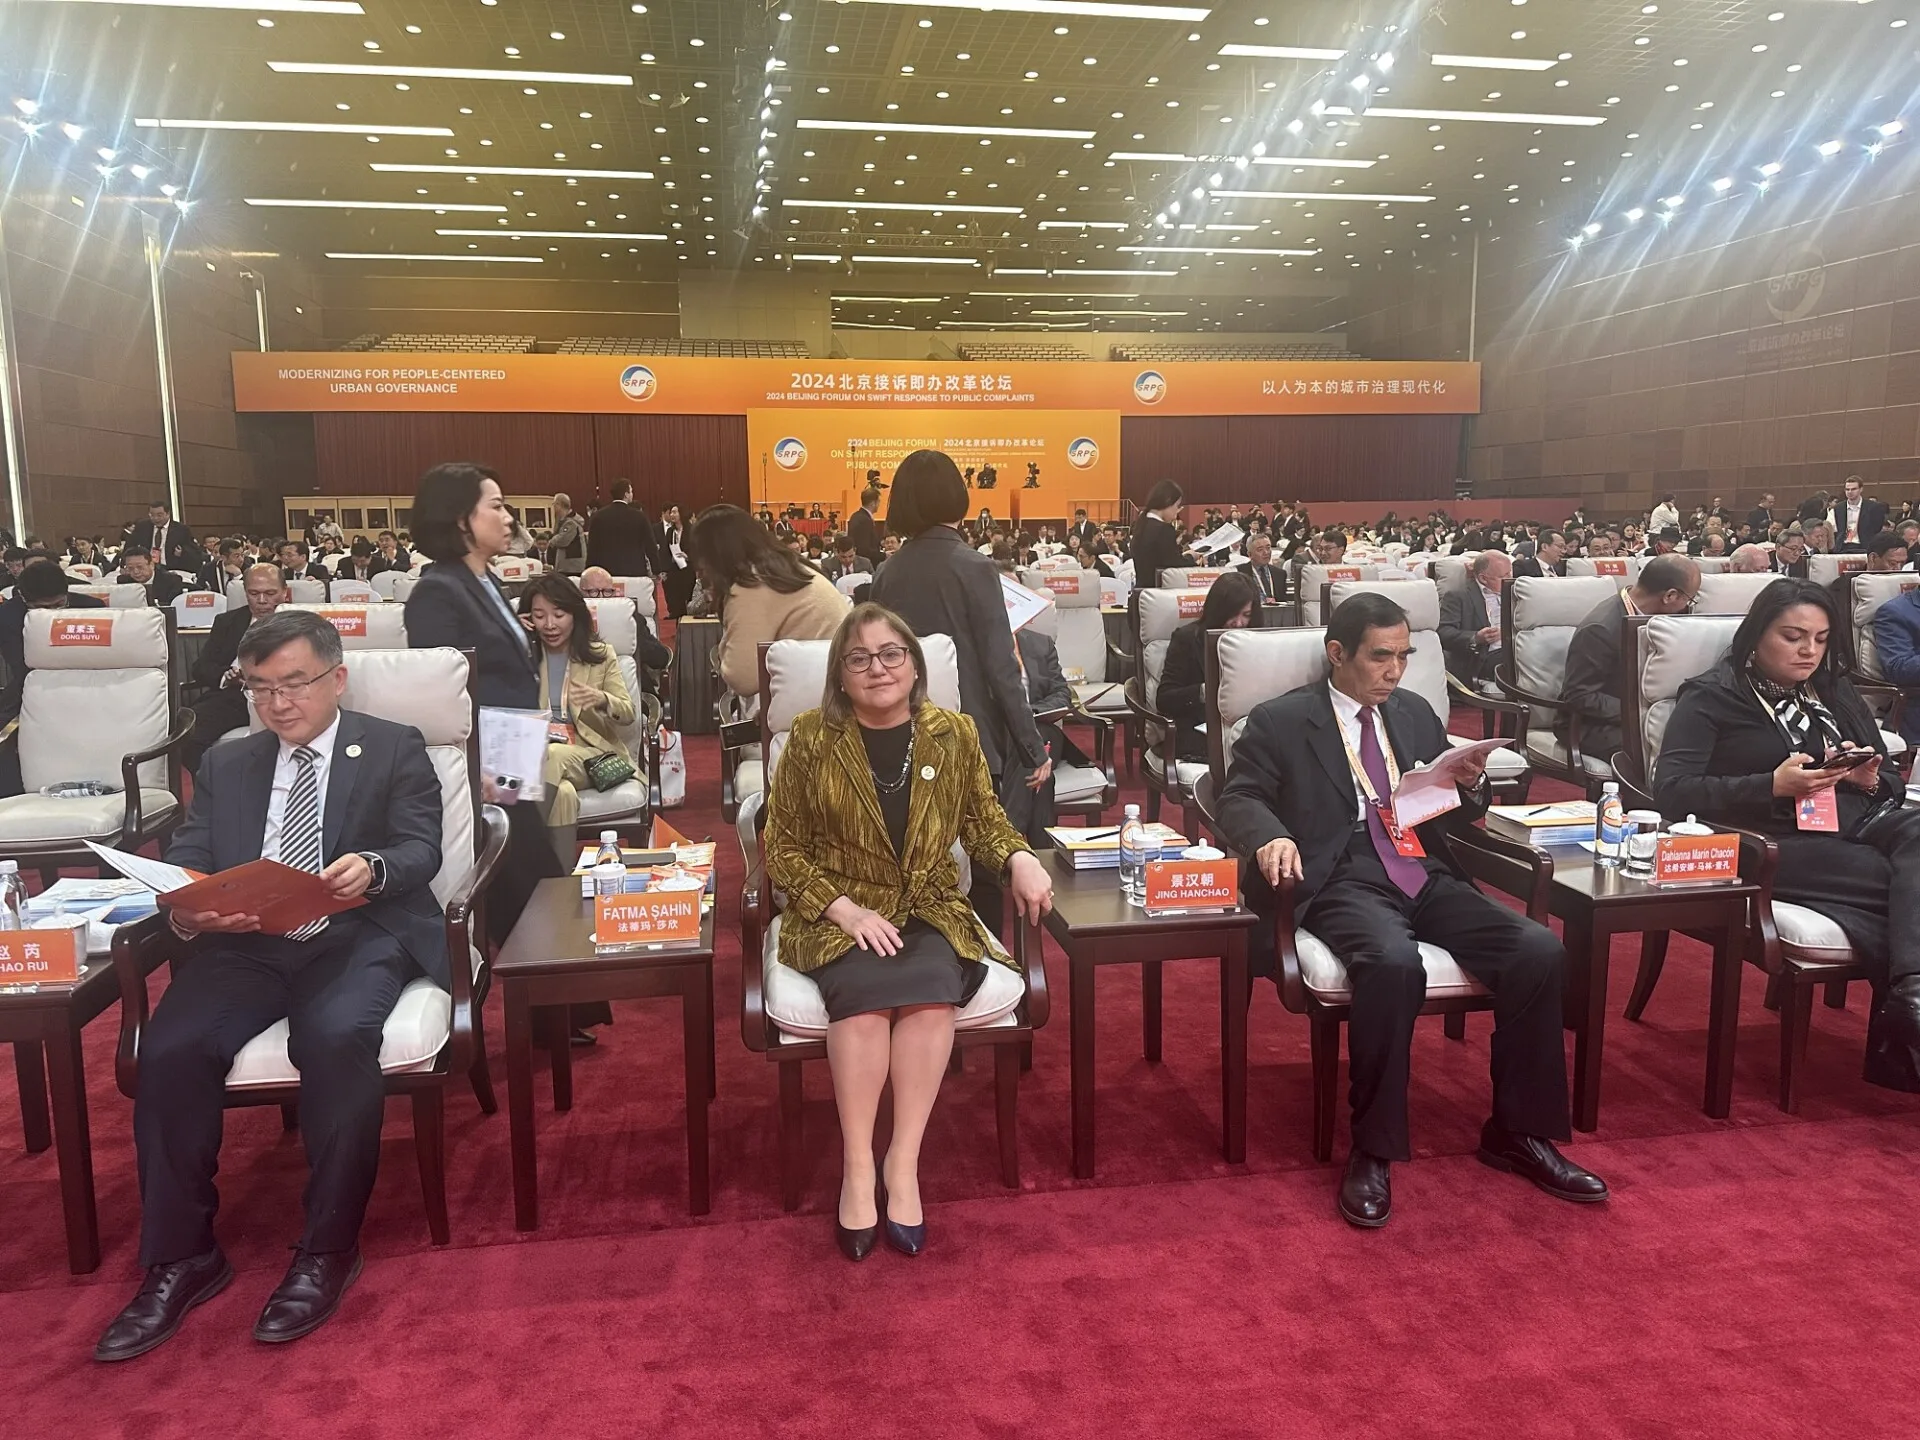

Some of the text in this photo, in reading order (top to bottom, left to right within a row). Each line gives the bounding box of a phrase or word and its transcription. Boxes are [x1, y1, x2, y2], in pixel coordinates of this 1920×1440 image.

[278, 369, 506, 380] MODERNIZING FOR PEOPLE-CENTERED
[624, 379, 653, 388] SRPC
[791, 373, 1012, 391] 2024北京接诉即办改革论坛
[1262, 379, 1446, 394] 以人为本的城市治理现代化
[330, 383, 458, 393] URBAN GOVERNANCE
[1137, 383, 1163, 392] SRPC
[766, 392, 1034, 402] 2024 BEIJING FORUM ON SWIFT RESPONSE TO PUBLIC COMPLAINTS
[869, 439, 903, 447] BEIJING
[905, 439, 937, 447] FORUM
[777, 450, 804, 458] SRPC
[831, 450, 913, 458] ON SWIFT RESPON
[1071, 450, 1097, 458] SRPC
[846, 461, 879, 469] PUBLIC
[1692, 848, 1710, 860] Marín
[1711, 846, 1735, 858] Chacón
[1171, 873, 1214, 887] 景汉朝
[1155, 888, 1230, 899] JING HANCHAO
[603, 901, 692, 920] FATMA ŞAHİN
[618, 919, 678, 932] 法蒂玛·莎欣
[0, 961, 48, 972] HAO RUI
